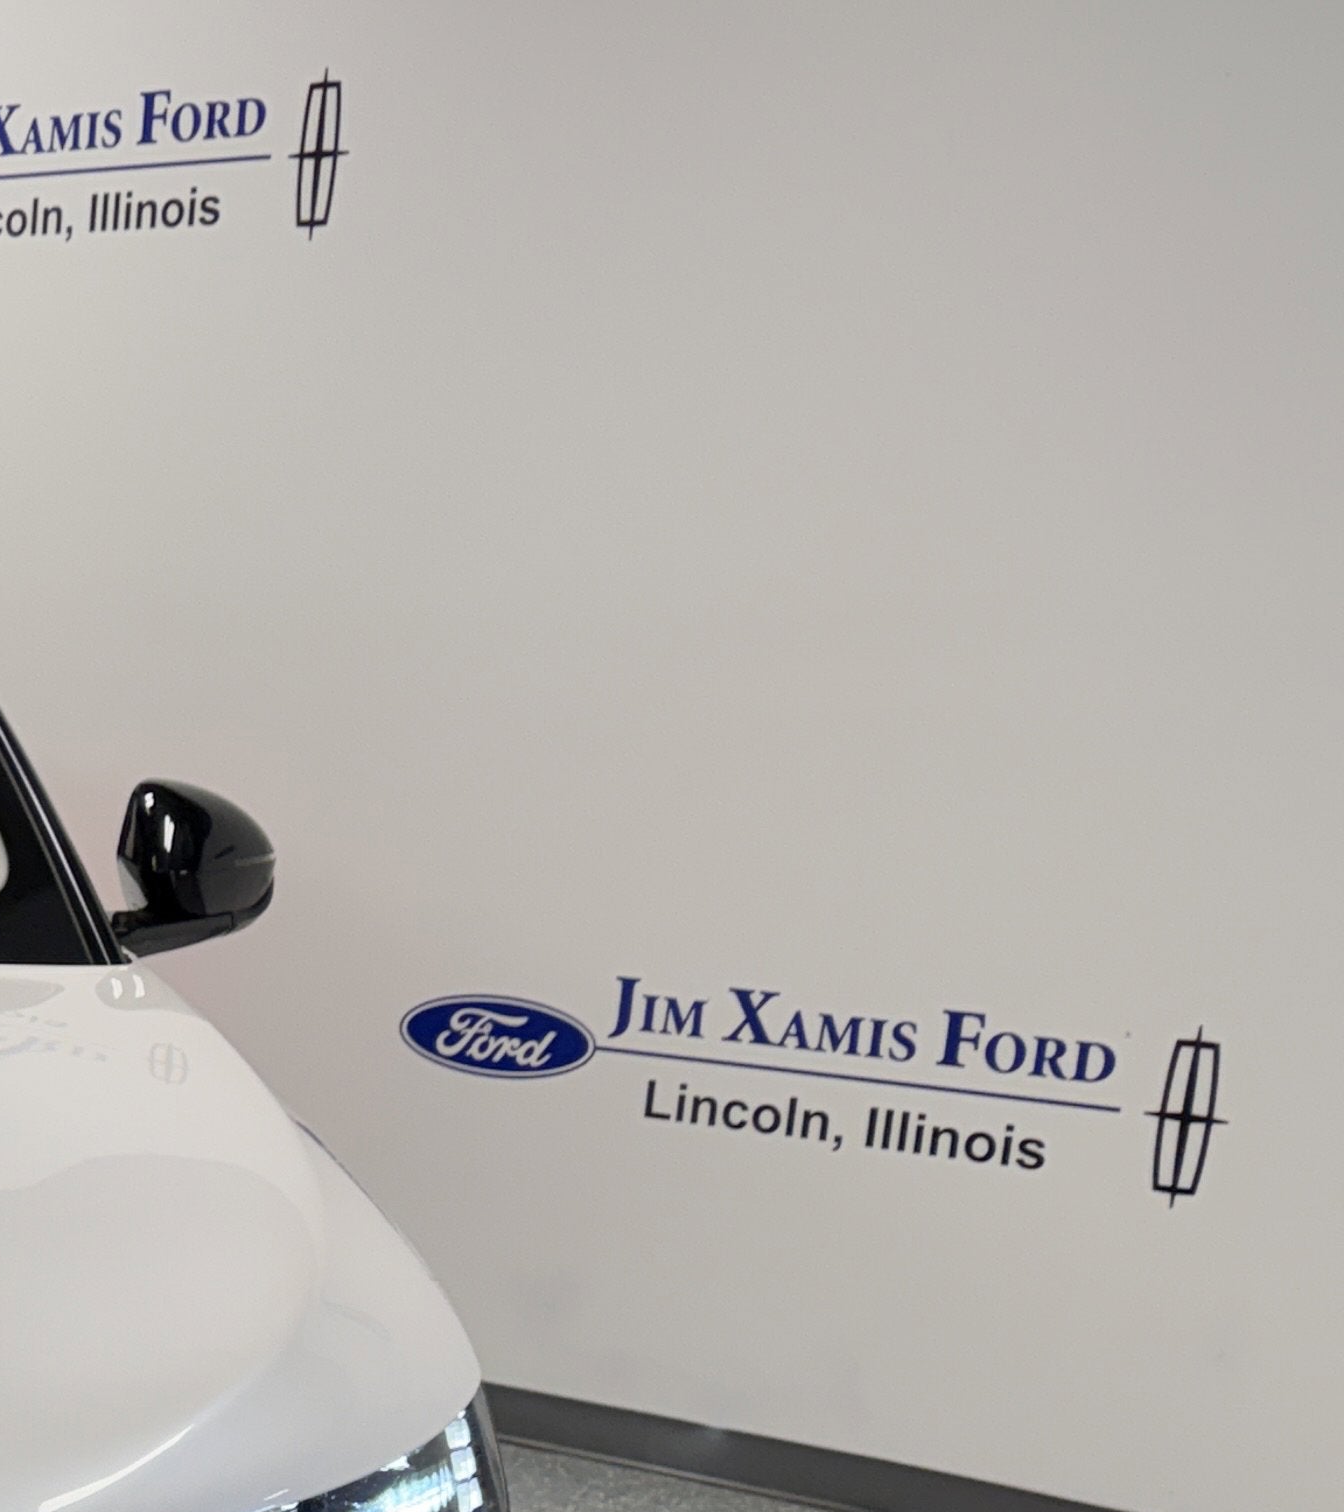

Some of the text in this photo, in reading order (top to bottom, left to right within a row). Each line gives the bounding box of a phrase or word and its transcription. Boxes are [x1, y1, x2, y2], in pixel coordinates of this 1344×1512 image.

[138, 90, 266, 146] FORD
[89, 187, 221, 234] Illinois
[436, 1008, 552, 1070] Ford
[609, 975, 1117, 1085] JIM XAMIS FORD
[644, 1079, 1046, 1171] Lincoln, Illinois
